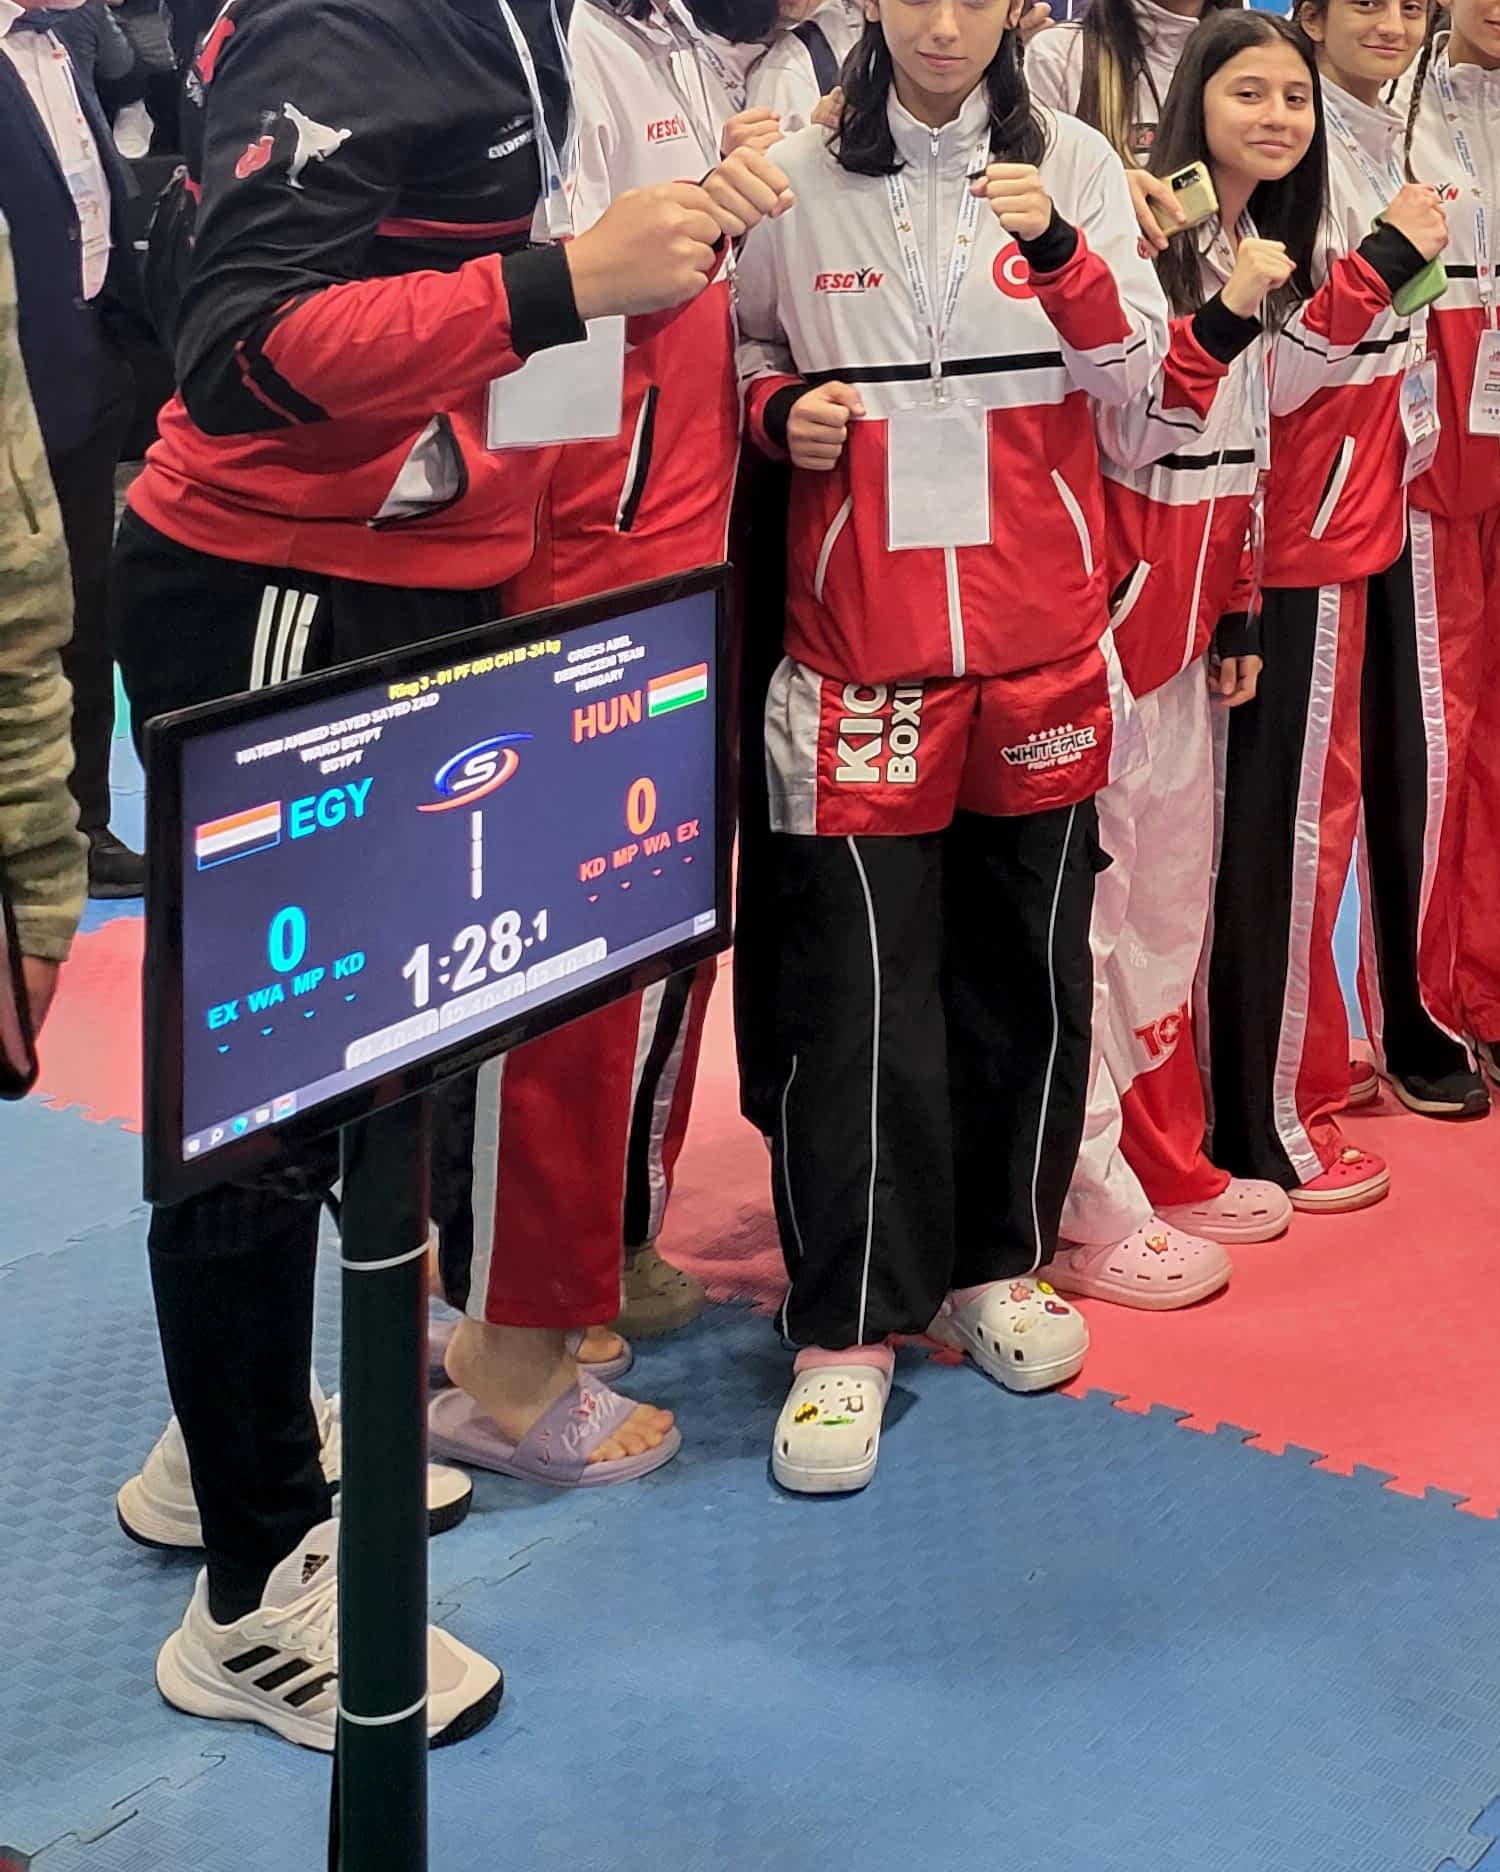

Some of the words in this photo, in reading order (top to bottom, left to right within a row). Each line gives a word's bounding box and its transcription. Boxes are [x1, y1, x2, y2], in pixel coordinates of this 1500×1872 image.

[574, 668, 624, 693] HUNGARY
[573, 689, 642, 743] HUN
[887, 681, 925, 783] BOXI
[289, 777, 374, 839] EGY
[627, 777, 656, 835] 0
[580, 857, 606, 882] KD
[613, 843, 639, 869] MP
[643, 832, 671, 856] WA
[676, 819, 699, 843] EX
[268, 906, 307, 973] 0
[402, 909, 548, 1008] 1:28.1
[208, 1000, 239, 1029] EX
[248, 983, 285, 1013] WA
[292, 967, 324, 997] MP
[332, 951, 365, 980] KD
